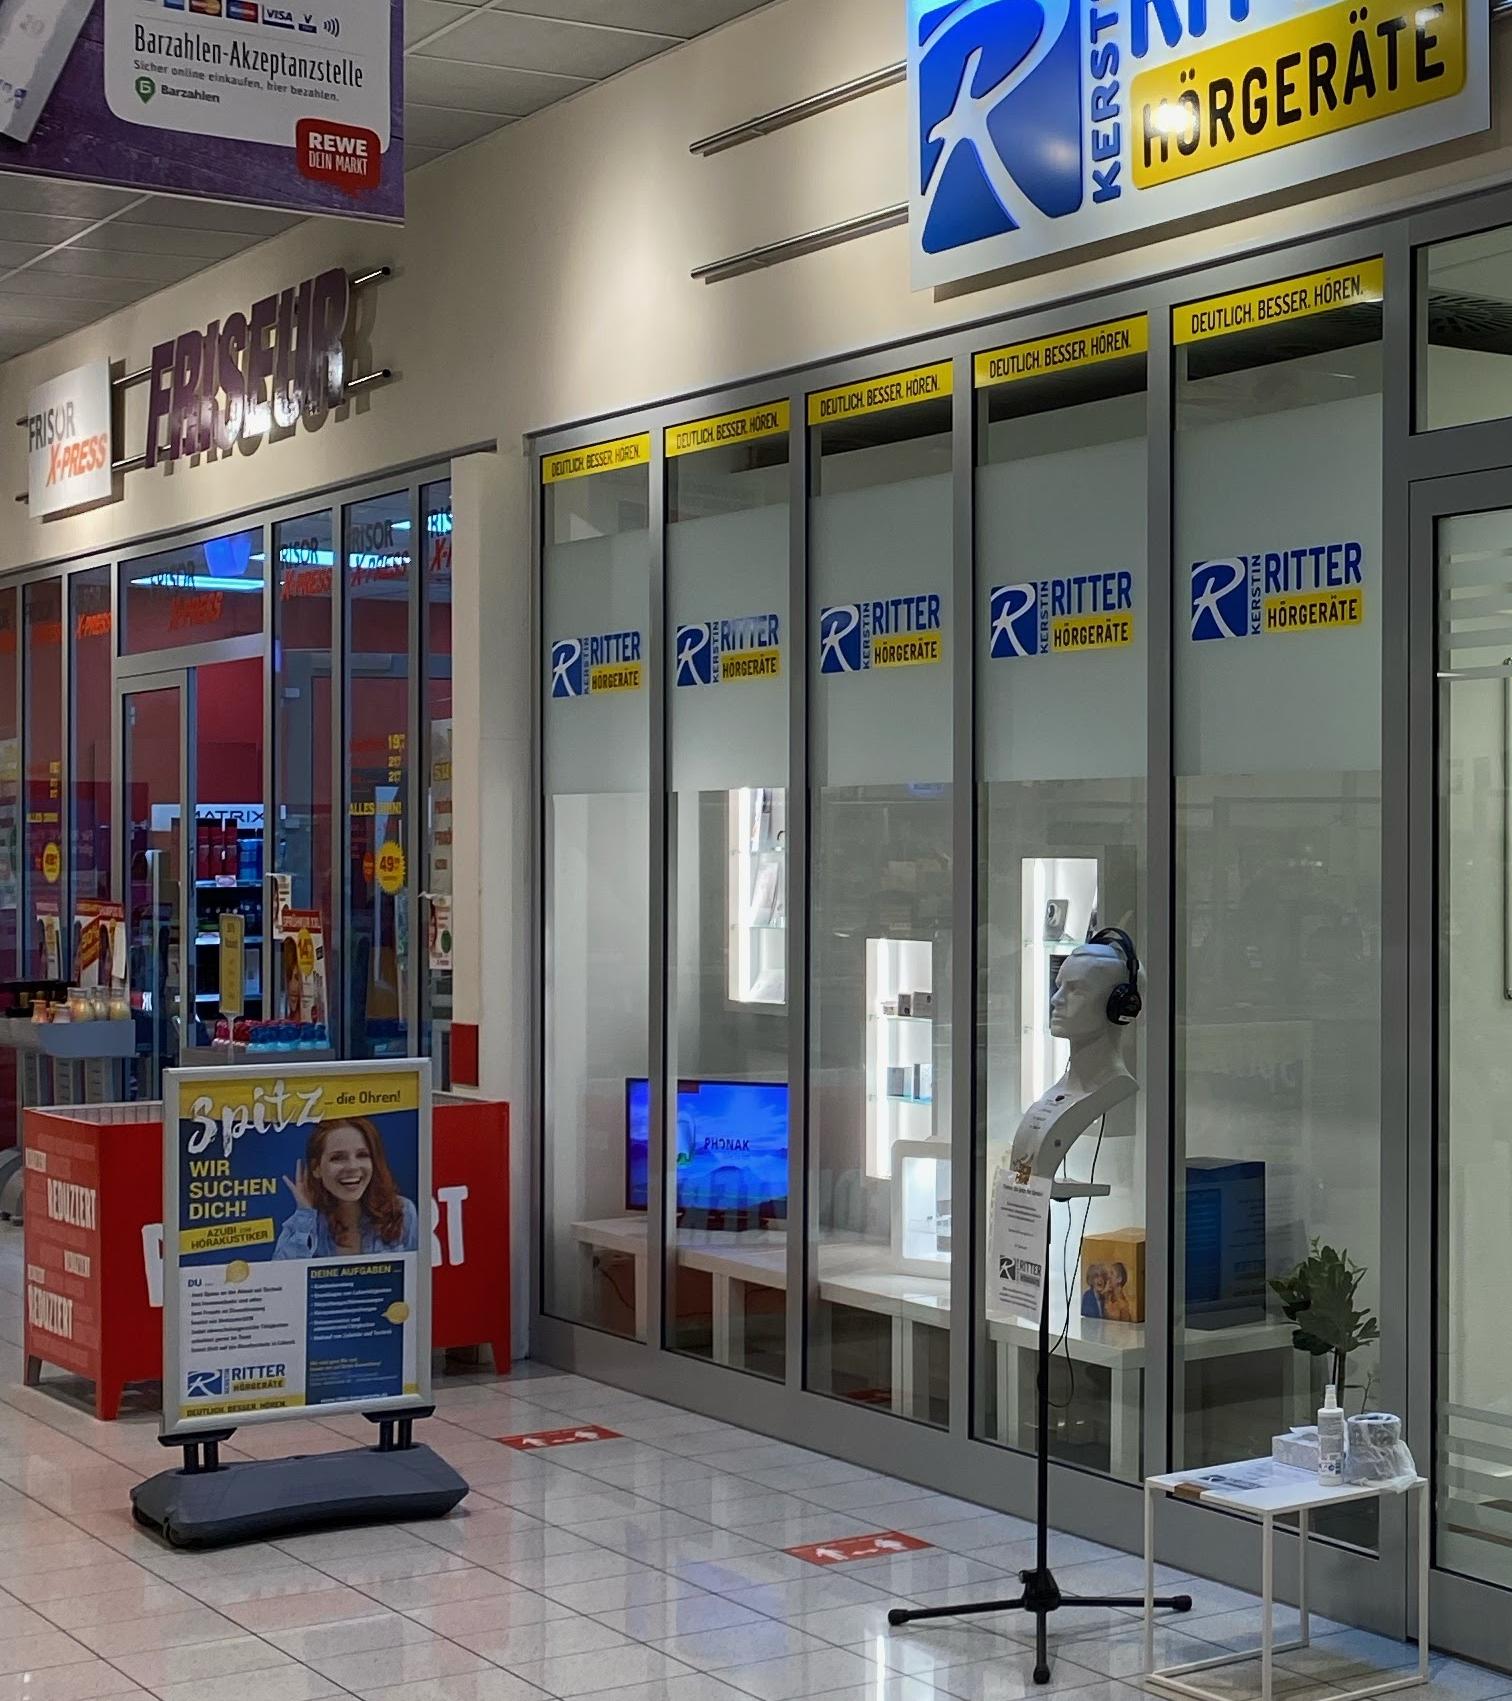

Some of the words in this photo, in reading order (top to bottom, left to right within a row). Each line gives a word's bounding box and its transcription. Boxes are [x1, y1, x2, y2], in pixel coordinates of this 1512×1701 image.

[267, 9, 294, 22] VISA
[134, 23, 364, 88] Barzahlen-Akzeptanzstelle
[133, 59, 168, 75] Sicher
[171, 67, 206, 81] online
[208, 73, 264, 90] einkaufen,
[266, 80, 292, 94] hier
[291, 84, 340, 102] bezahlen.
[160, 84, 221, 104] Barzahlen
[1143, 5, 1447, 169] HÖRGERÄTE
[1089, 0, 1121, 204] KERST
[308, 131, 368, 157] REWE
[308, 153, 333, 172] DEIN
[334, 156, 368, 176] MARKT
[1191, 302, 1255, 335] DEUTLICH.
[1258, 291, 1311, 321] BESSER.
[1314, 274, 1364, 309] HÖREN.
[145, 268, 349, 469] FRISEUR
[989, 349, 1043, 379] DEUTLICH.
[1044, 340, 1089, 367] BESSER.
[1090, 329, 1132, 357] HÖREN.
[820, 388, 865, 417] DEUTLICH.
[866, 380, 905, 406] BESSER.
[905, 373, 940, 398] HÖREN.
[676, 425, 715, 450] DEUTLICH.
[716, 417, 748, 441] BESSER.
[748, 409, 779, 434] HÖREN.
[45, 432, 108, 488] X-PRESS
[1264, 542, 1362, 594] RITTER
[1051, 571, 1132, 617] RITTER
[1250, 554, 1261, 635] KERSTIN
[1267, 594, 1358, 629] HÖRGERÄTE
[720, 613, 779, 652] RITTER
[872, 594, 940, 637] RITTER
[1039, 580, 1049, 654] KERSTIN
[1053, 617, 1129, 648] HÖRGERÄTE
[590, 630, 641, 665] RITTER
[862, 602, 870, 670] KERSTIN
[874, 637, 938, 666] HÖRGERÄTE
[591, 666, 639, 690] HÖRGERÄTE
[722, 652, 777, 679] HÖRGERÄTE
[348, 802, 375, 816] ALLES
[187, 1079, 324, 1158] Spitz
[336, 1091, 356, 1106] die
[358, 1090, 401, 1105] Ohren!
[704, 1136, 750, 1151] PHONAK
[188, 1159, 231, 1178] WIR
[188, 1178, 278, 1200] SUCHEN
[188, 1200, 248, 1221] DICH!
[206, 1226, 237, 1238] AZUBI
[187, 1278, 202, 1287] DU
[310, 1268, 340, 1280] DEINE
[341, 1264, 392, 1277] AUFGABEN
[1019, 1259, 1042, 1277] RITTER
[231, 1363, 286, 1381] RITTER
